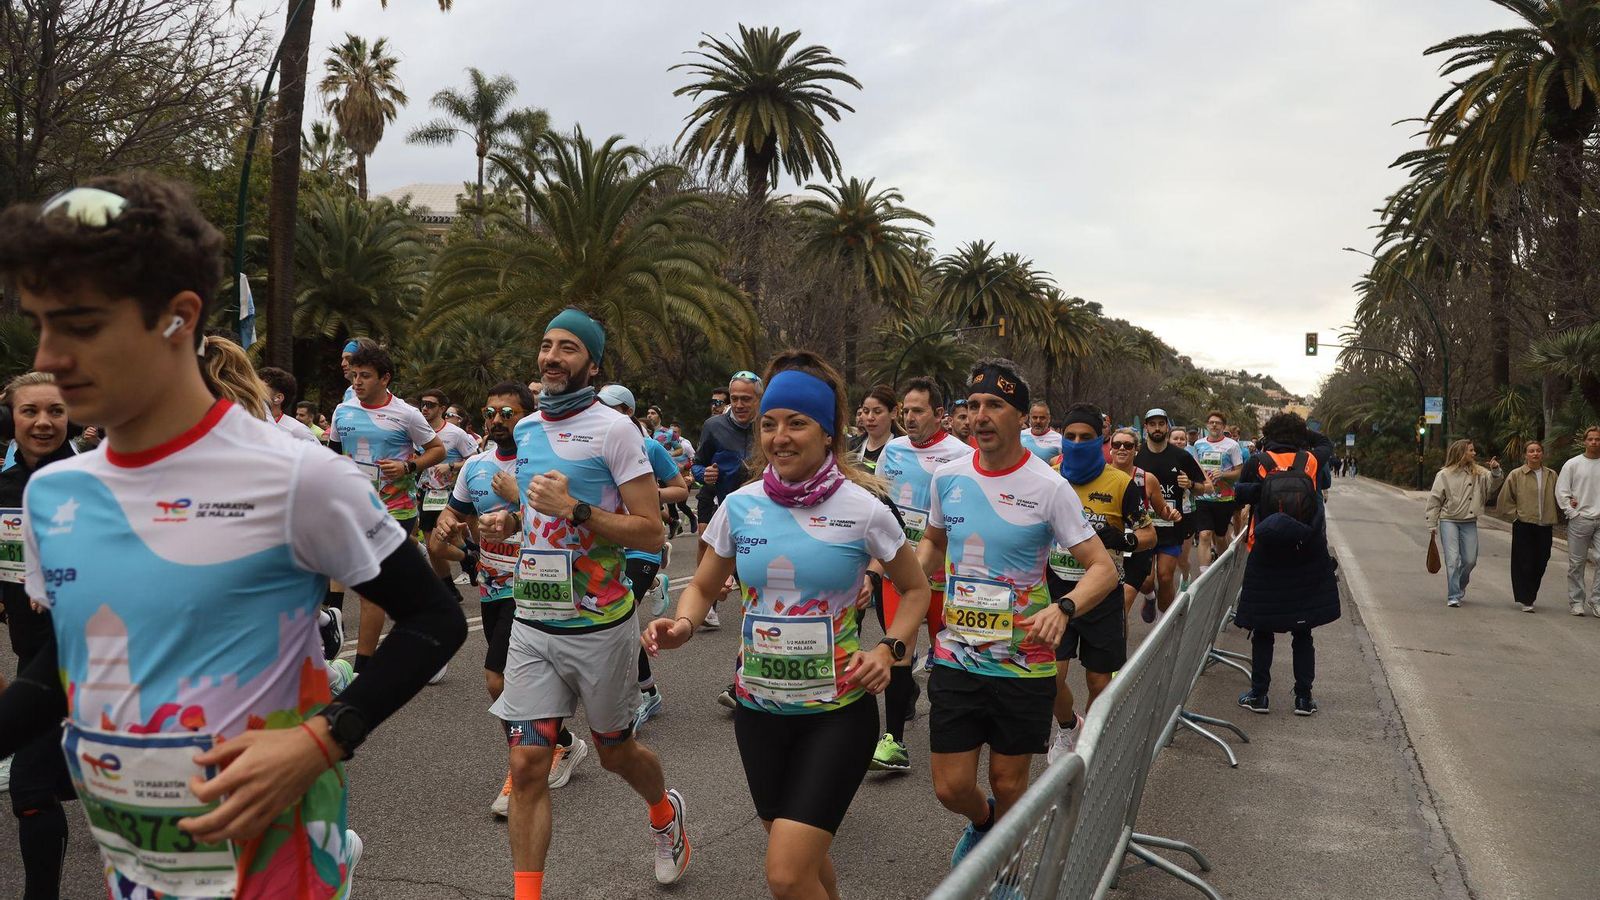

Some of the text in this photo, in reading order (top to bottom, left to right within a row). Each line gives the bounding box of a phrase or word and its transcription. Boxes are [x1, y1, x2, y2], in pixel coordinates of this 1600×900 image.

[212, 502, 256, 511] MARATÓN
[208, 510, 246, 518] MÁLAGA
[1085, 513, 1107, 522] RAIL
[523, 581, 561, 600] 4983
[956, 609, 1001, 630] 2687
[761, 657, 819, 681] 5986
[146, 780, 186, 789] MARATÓN
[135, 789, 181, 800] DE MÁLAGA
